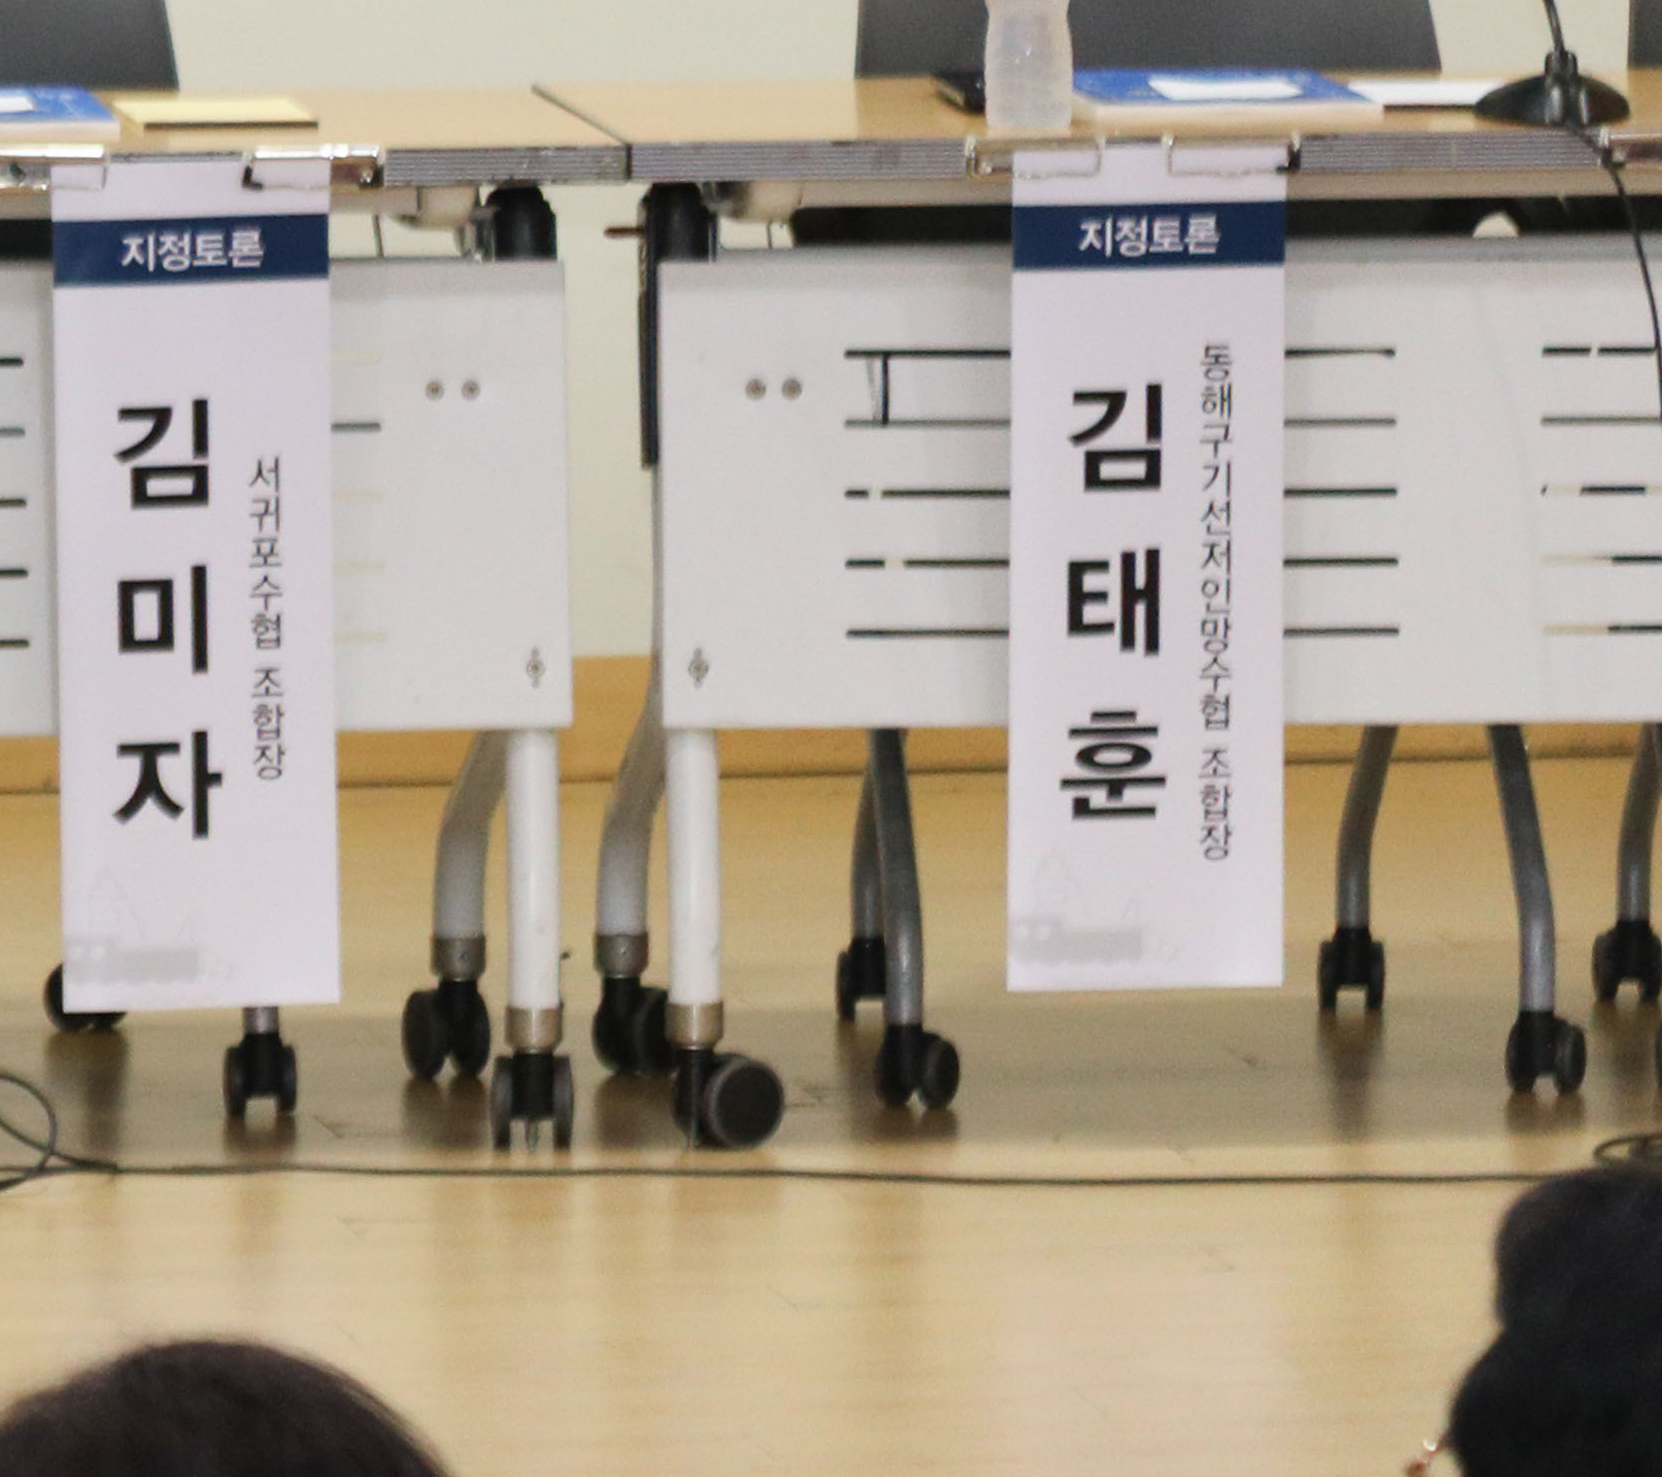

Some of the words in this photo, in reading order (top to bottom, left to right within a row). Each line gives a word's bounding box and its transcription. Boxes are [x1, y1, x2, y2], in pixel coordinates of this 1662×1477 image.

[120, 226, 266, 273] 지정토론
[1078, 213, 1221, 258] 지정토론
[248, 455, 283, 650] 서귀포수협
[1059, 382, 1166, 821] 김태훈
[1199, 340, 1234, 732] 동해구기선저인망수협
[113, 397, 224, 841] 김미자
[251, 666, 287, 781] 조합장
[1198, 748, 1234, 862] 조합장
